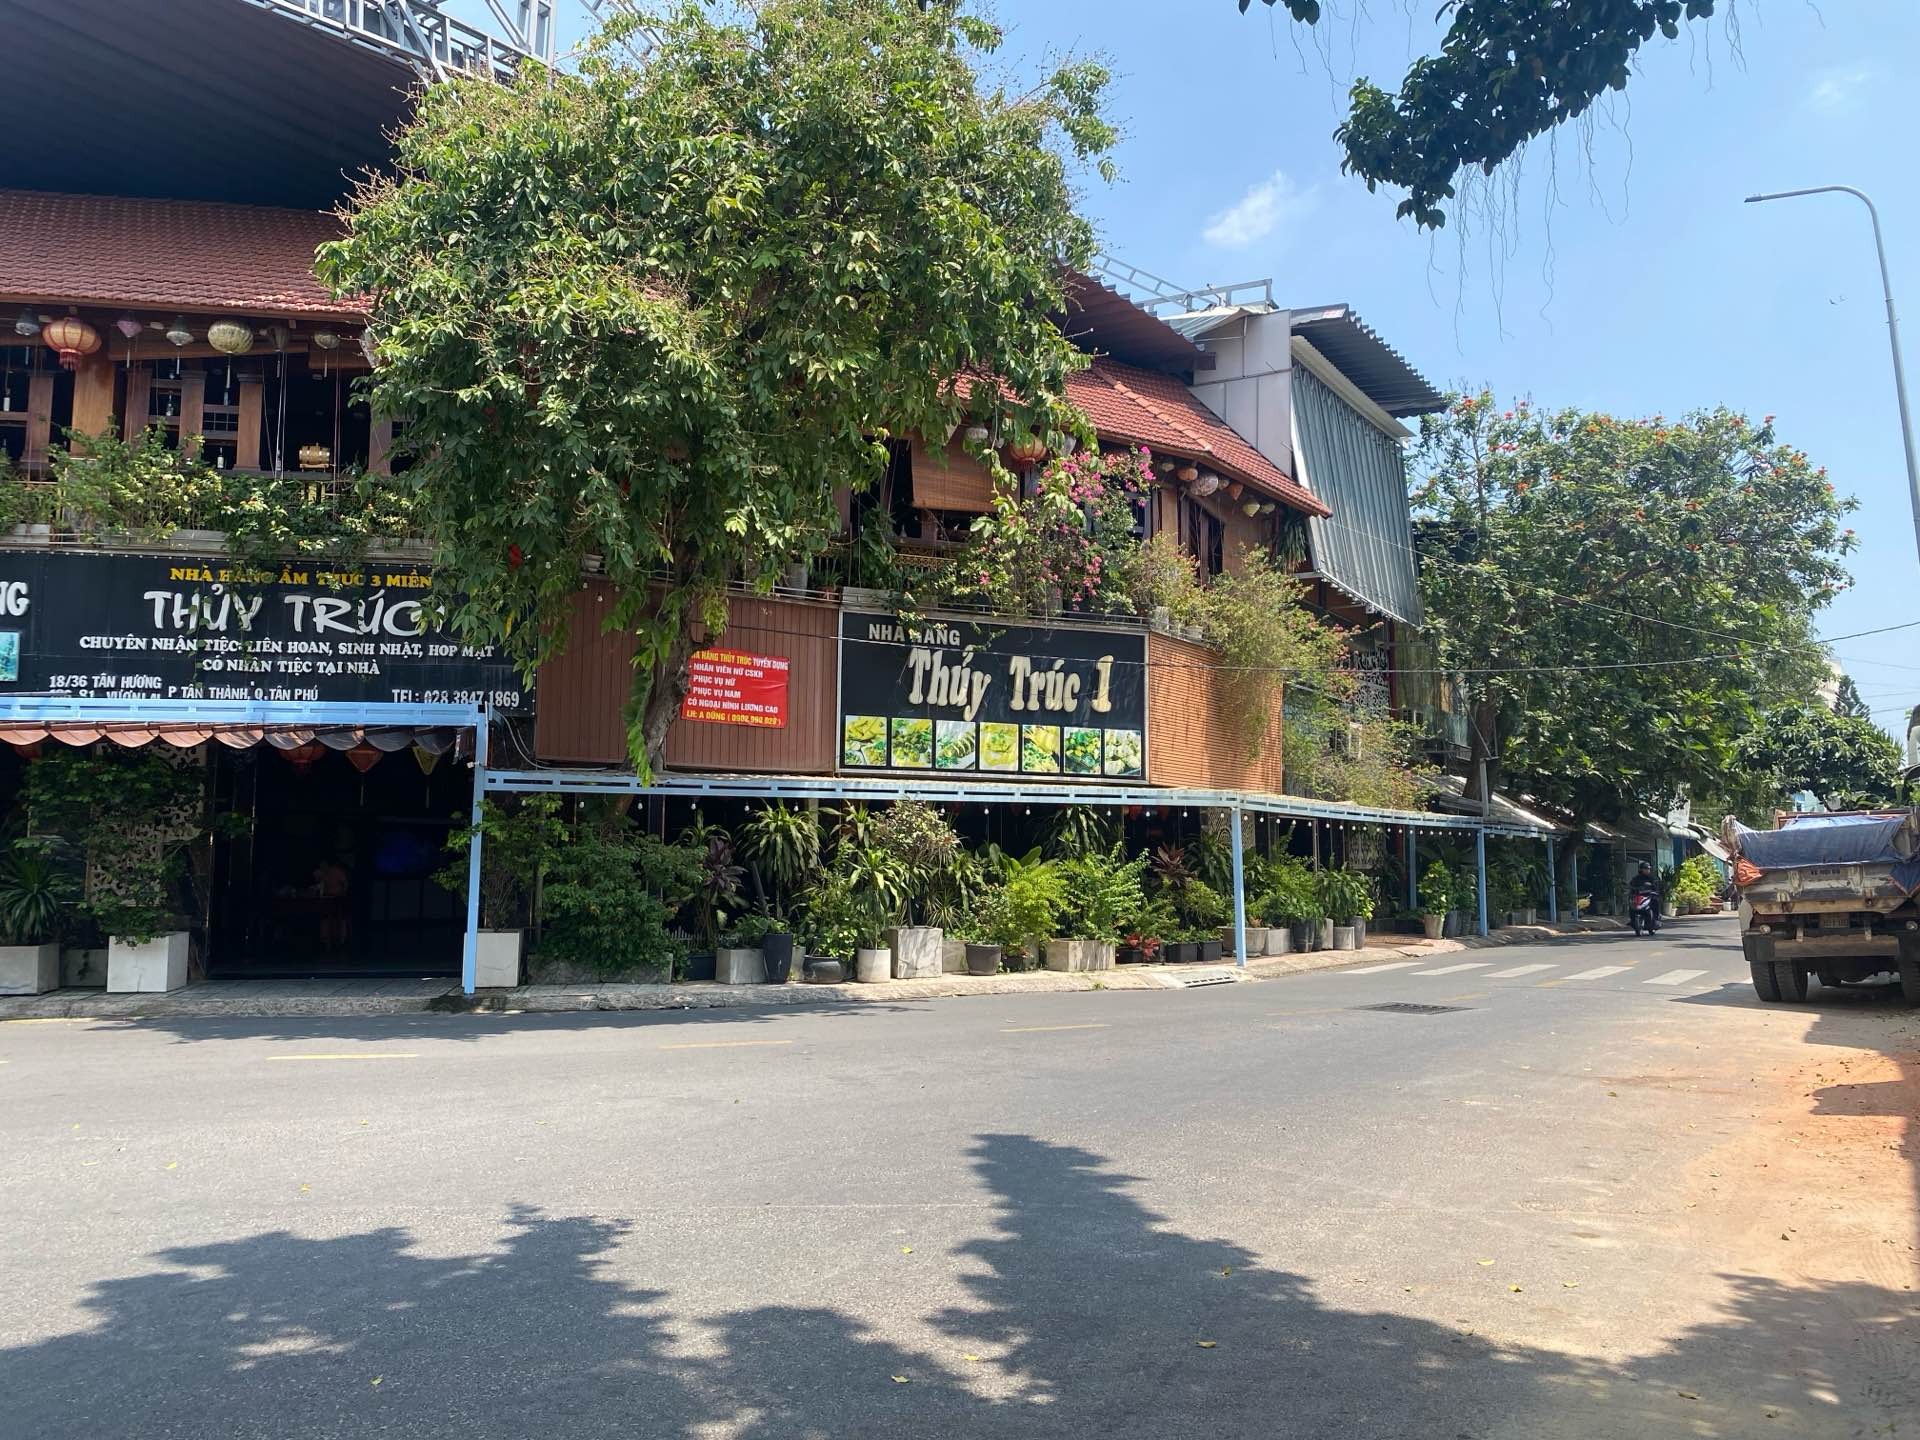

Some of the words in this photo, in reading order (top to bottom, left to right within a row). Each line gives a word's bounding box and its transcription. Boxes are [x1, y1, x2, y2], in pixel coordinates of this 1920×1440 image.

[170, 565, 212, 581] NHÀ
[370, 575, 381, 587] 3
[386, 569, 432, 588] MIỀN
[143, 583, 262, 631] THỦY
[284, 589, 424, 637] TRÚC
[79, 634, 148, 650] CHUYÊN
[151, 635, 198, 653] NHẬN
[247, 637, 283, 653] LIÊN
[287, 641, 333, 656] HOAN,
[338, 642, 375, 656] SINH
[380, 643, 424, 660] NHẬT,
[202, 655, 224, 671] CÓ
[277, 657, 312, 676] TIỆC
[316, 662, 343, 676] TẠI
[347, 659, 380, 675] NHÀ
[49, 675, 88, 688] 18/36
[92, 673, 116, 688] TÂN
[1009, 655, 1081, 712] Trúc
[1091, 654, 1114, 713] 1
[181, 683, 203, 698] TÂN
[294, 684, 319, 701] PHÚ
[724, 690, 741, 699] NAM
[765, 705, 779, 714] CAO
